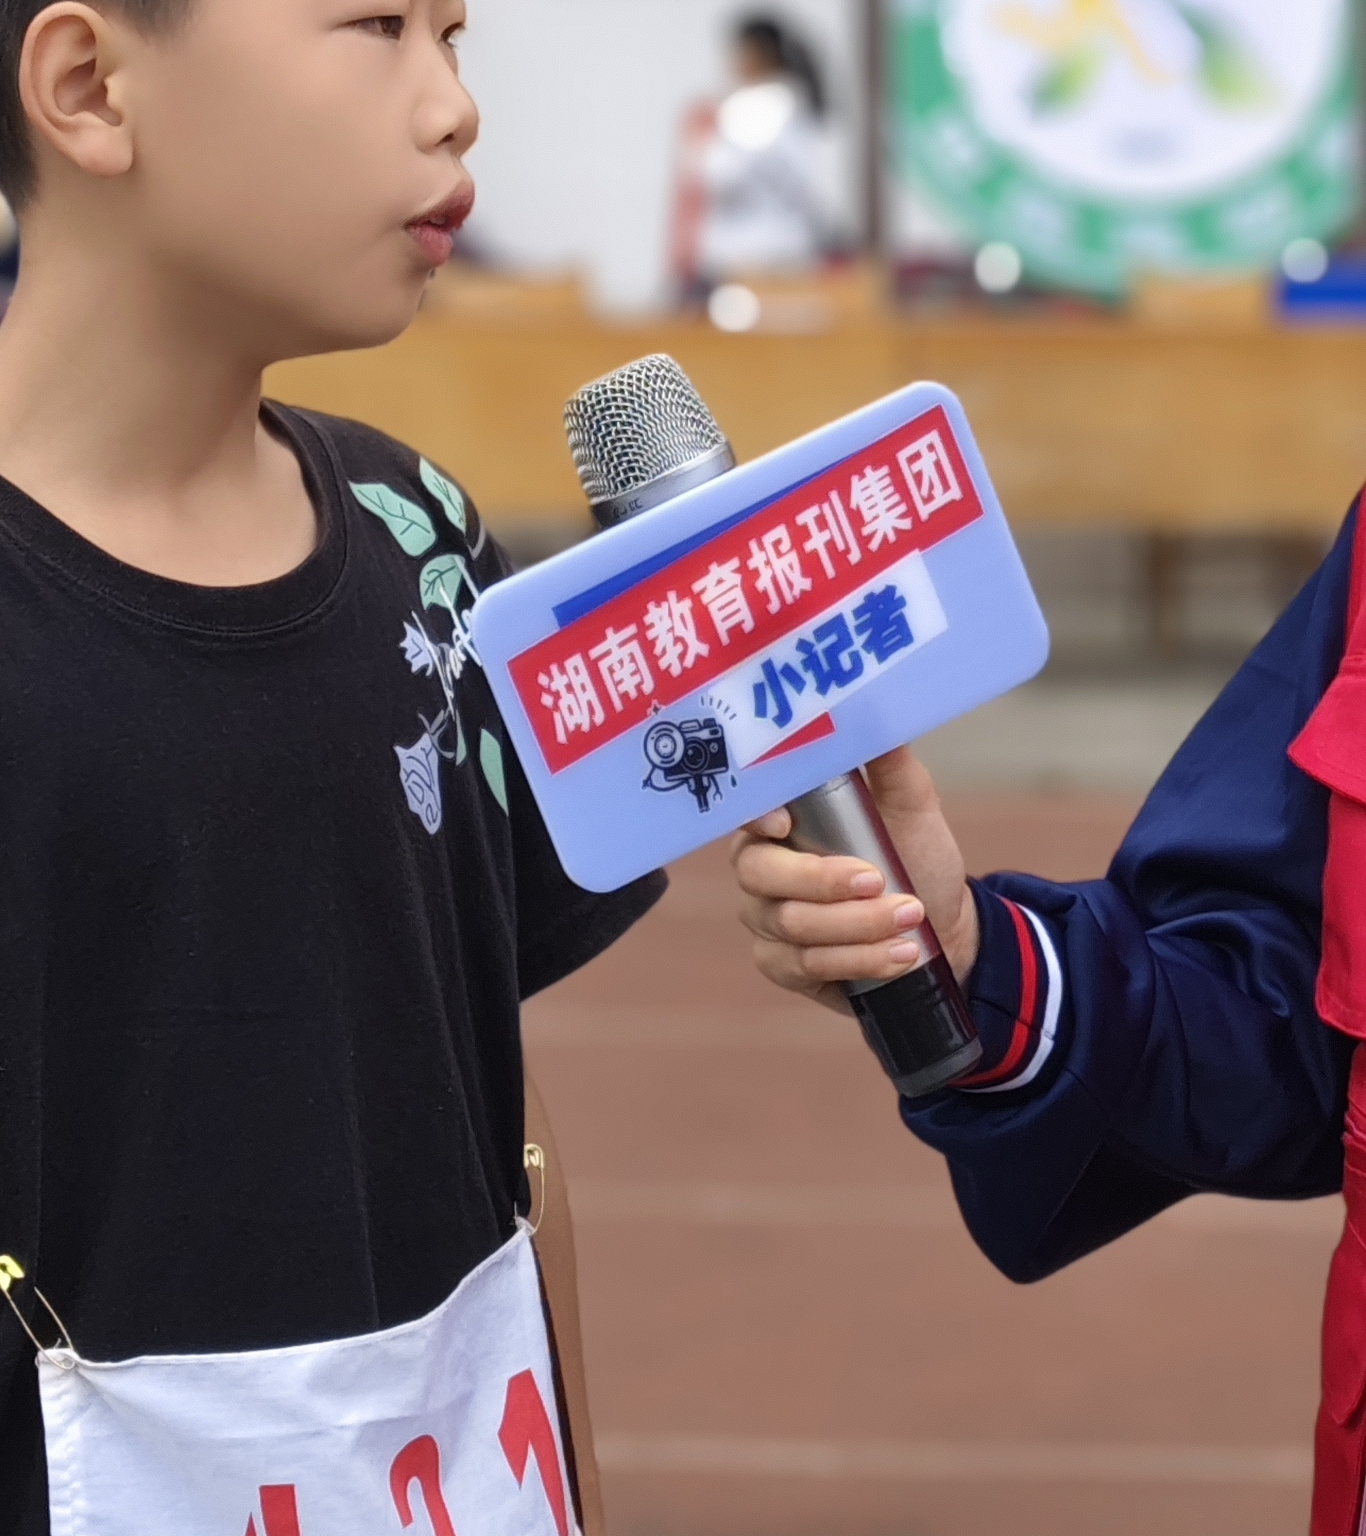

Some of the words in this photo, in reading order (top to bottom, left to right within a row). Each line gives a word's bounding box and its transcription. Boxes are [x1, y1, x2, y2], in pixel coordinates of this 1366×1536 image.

[536, 428, 965, 746] 湖南教育报刊集团
[753, 583, 914, 729] 小记者
